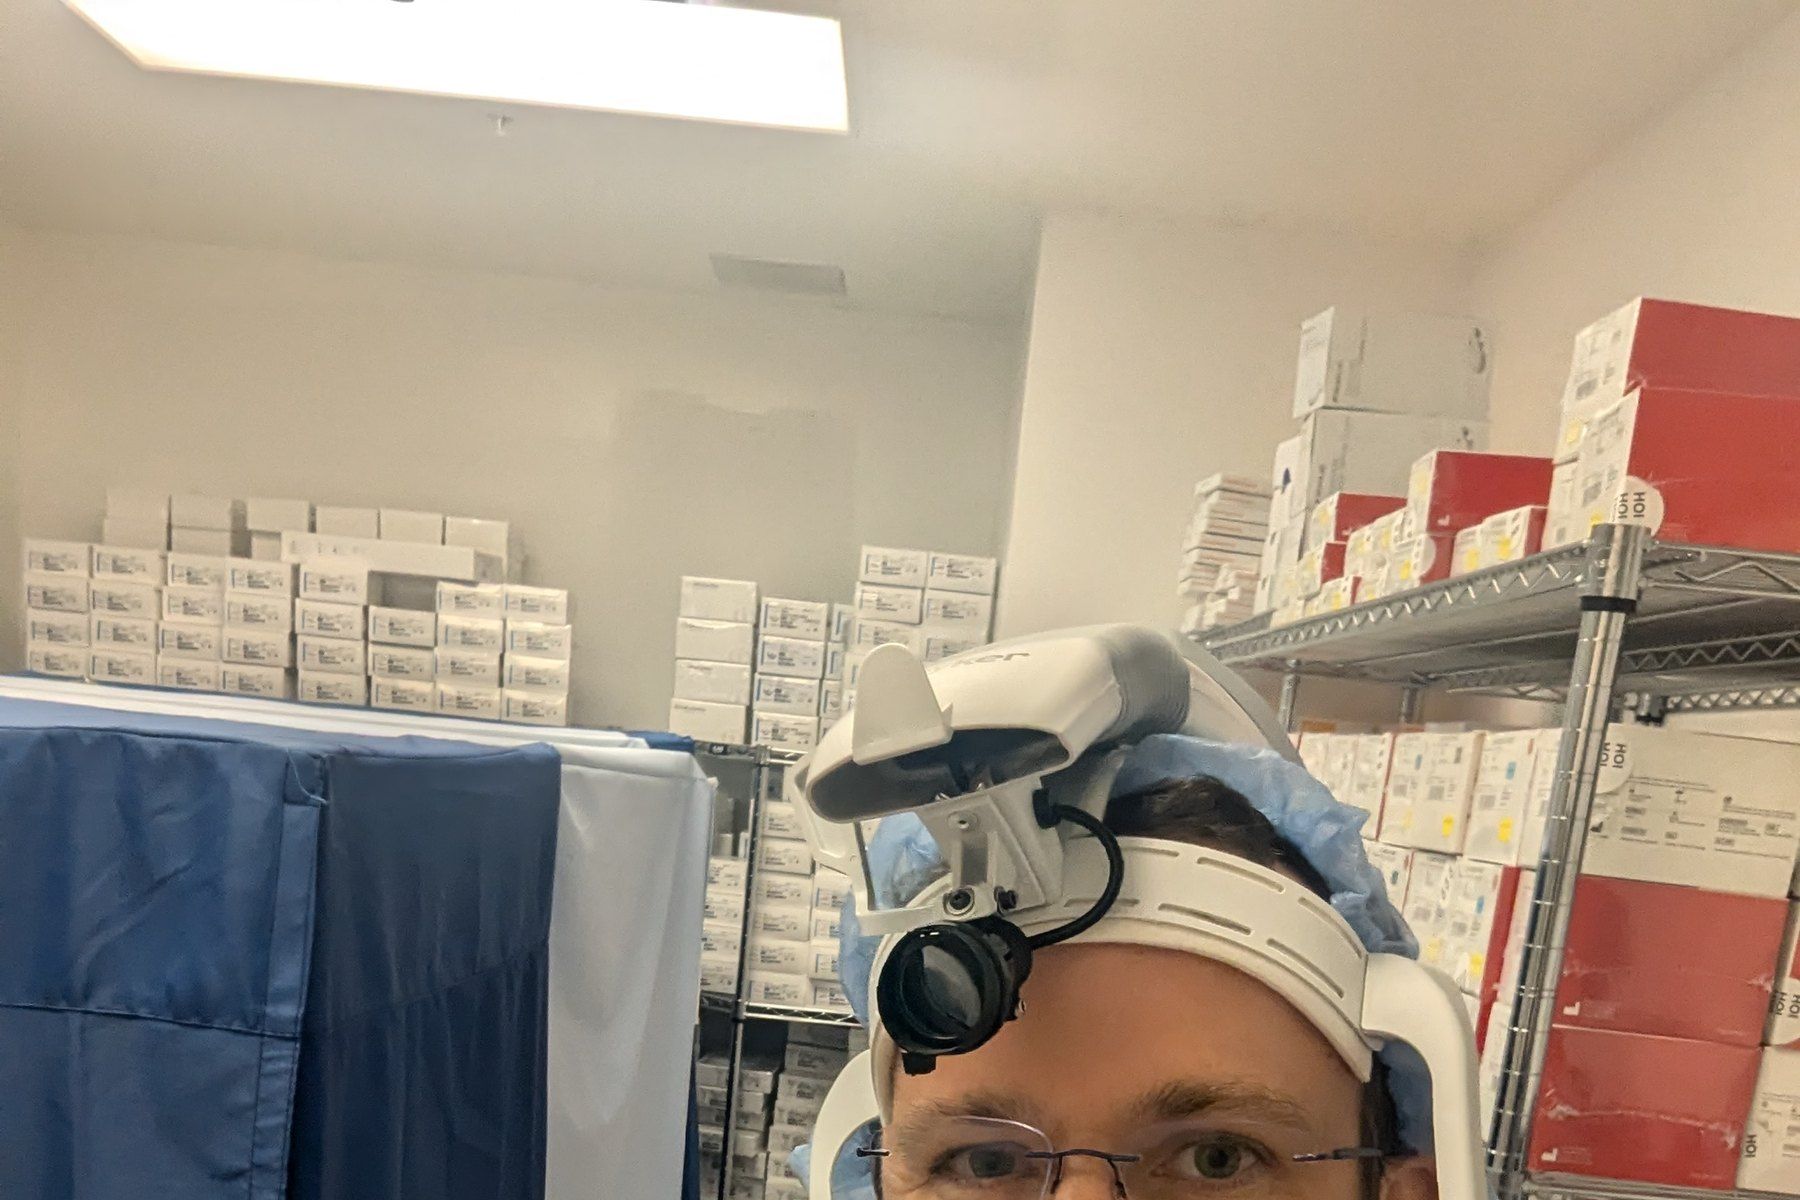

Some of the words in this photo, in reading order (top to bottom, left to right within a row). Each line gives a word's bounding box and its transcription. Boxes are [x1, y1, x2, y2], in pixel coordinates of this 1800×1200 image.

[1633, 491, 1646, 518] HOI
[1612, 743, 1626, 769] HOI
[1745, 1134, 1757, 1158] HOI
